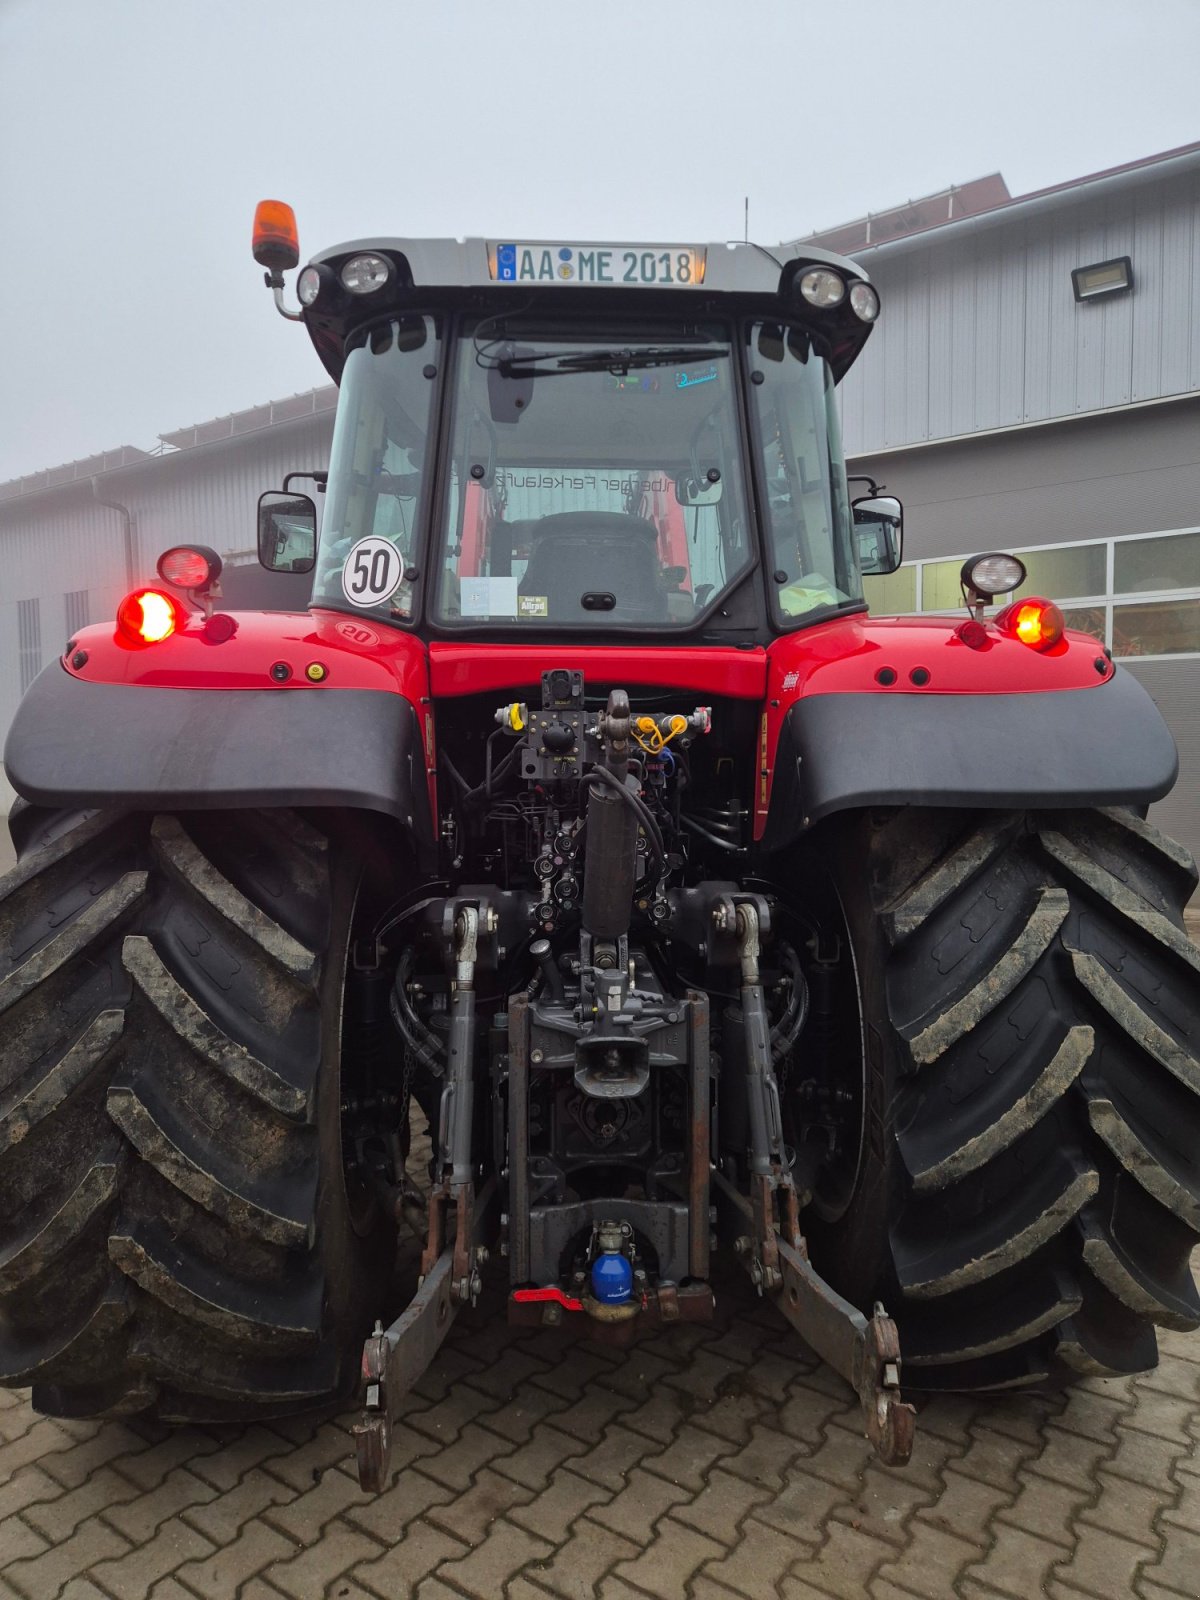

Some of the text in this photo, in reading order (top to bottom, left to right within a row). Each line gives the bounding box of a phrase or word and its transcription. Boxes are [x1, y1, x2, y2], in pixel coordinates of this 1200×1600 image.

[503, 250, 691, 283] D AA ME 2018
[351, 548, 391, 594] 50
